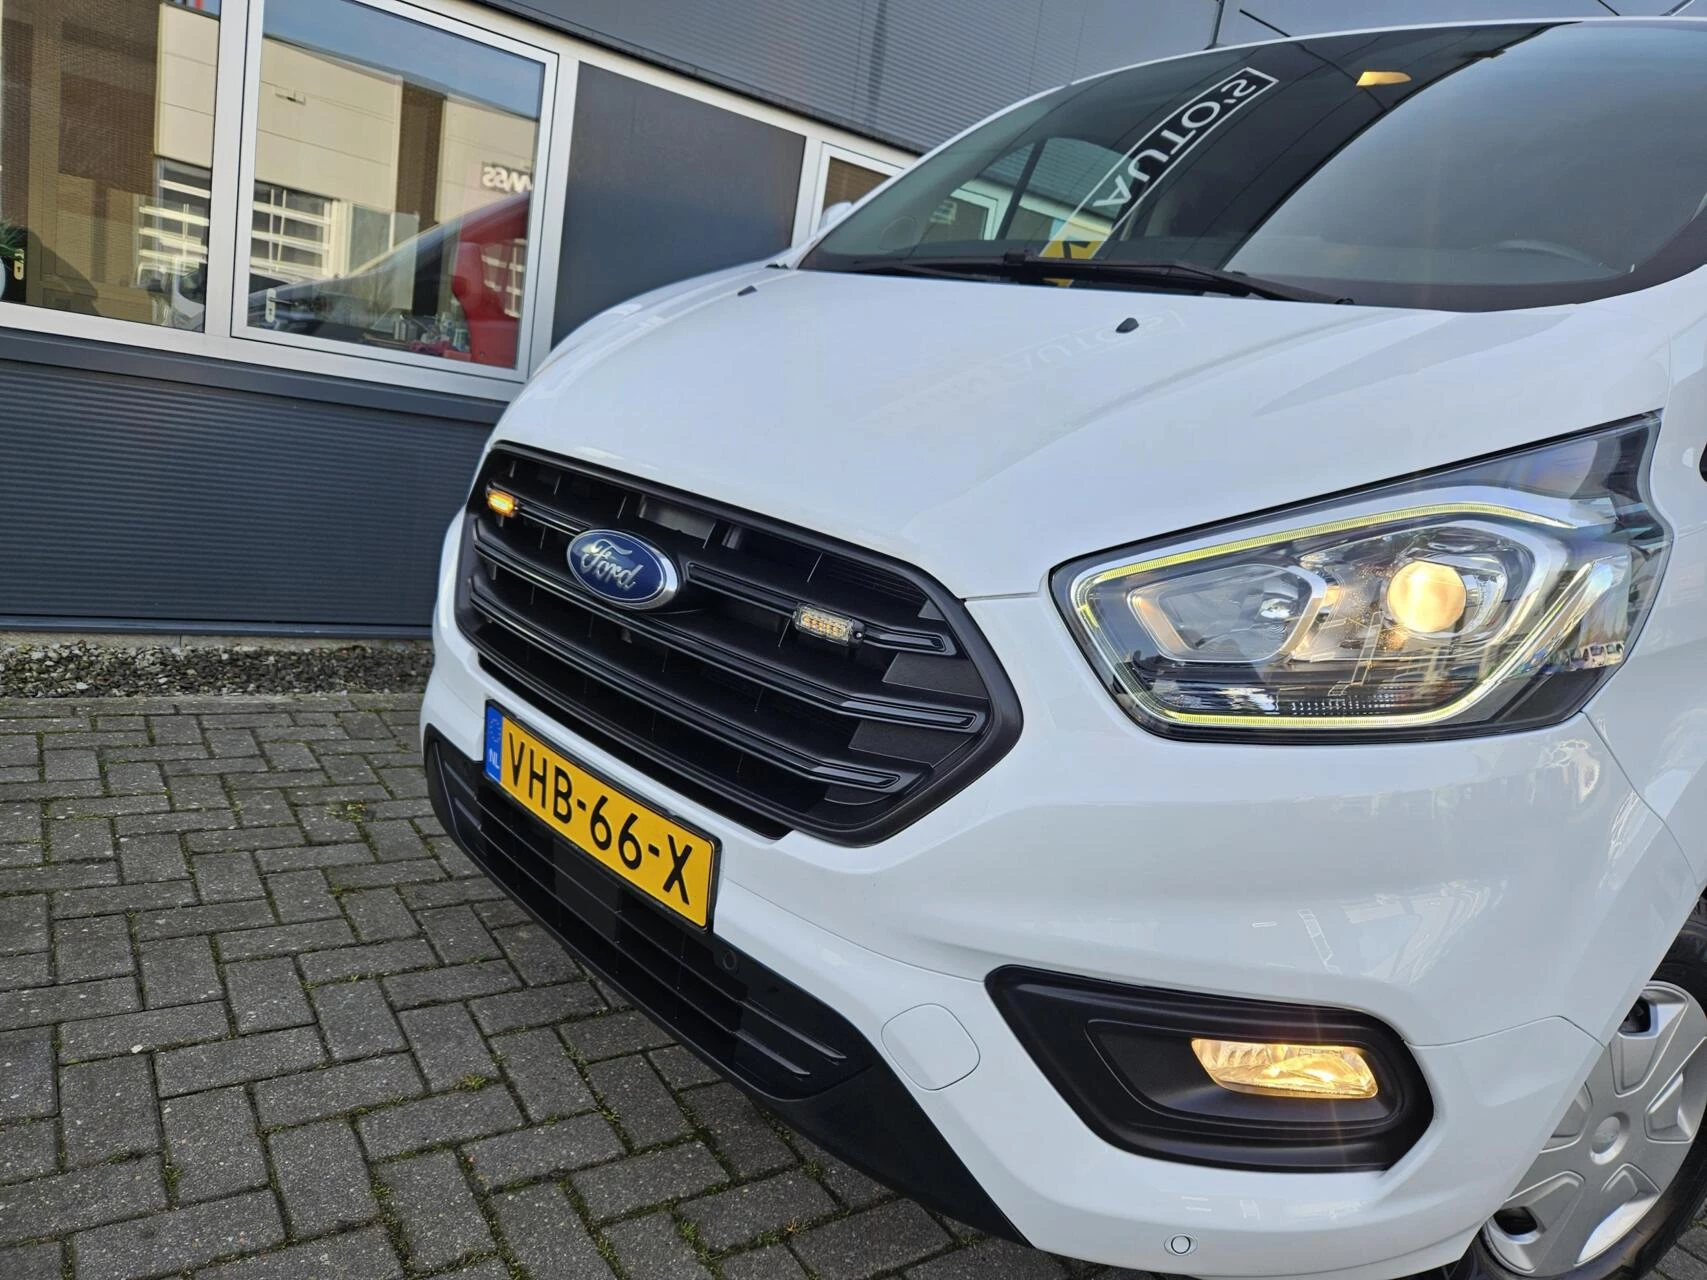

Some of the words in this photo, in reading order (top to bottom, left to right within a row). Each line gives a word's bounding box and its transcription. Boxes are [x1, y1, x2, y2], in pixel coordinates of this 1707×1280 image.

[581, 538, 644, 590] Ford
[488, 747, 501, 770] NL
[508, 731, 693, 906] VHB-66-X
